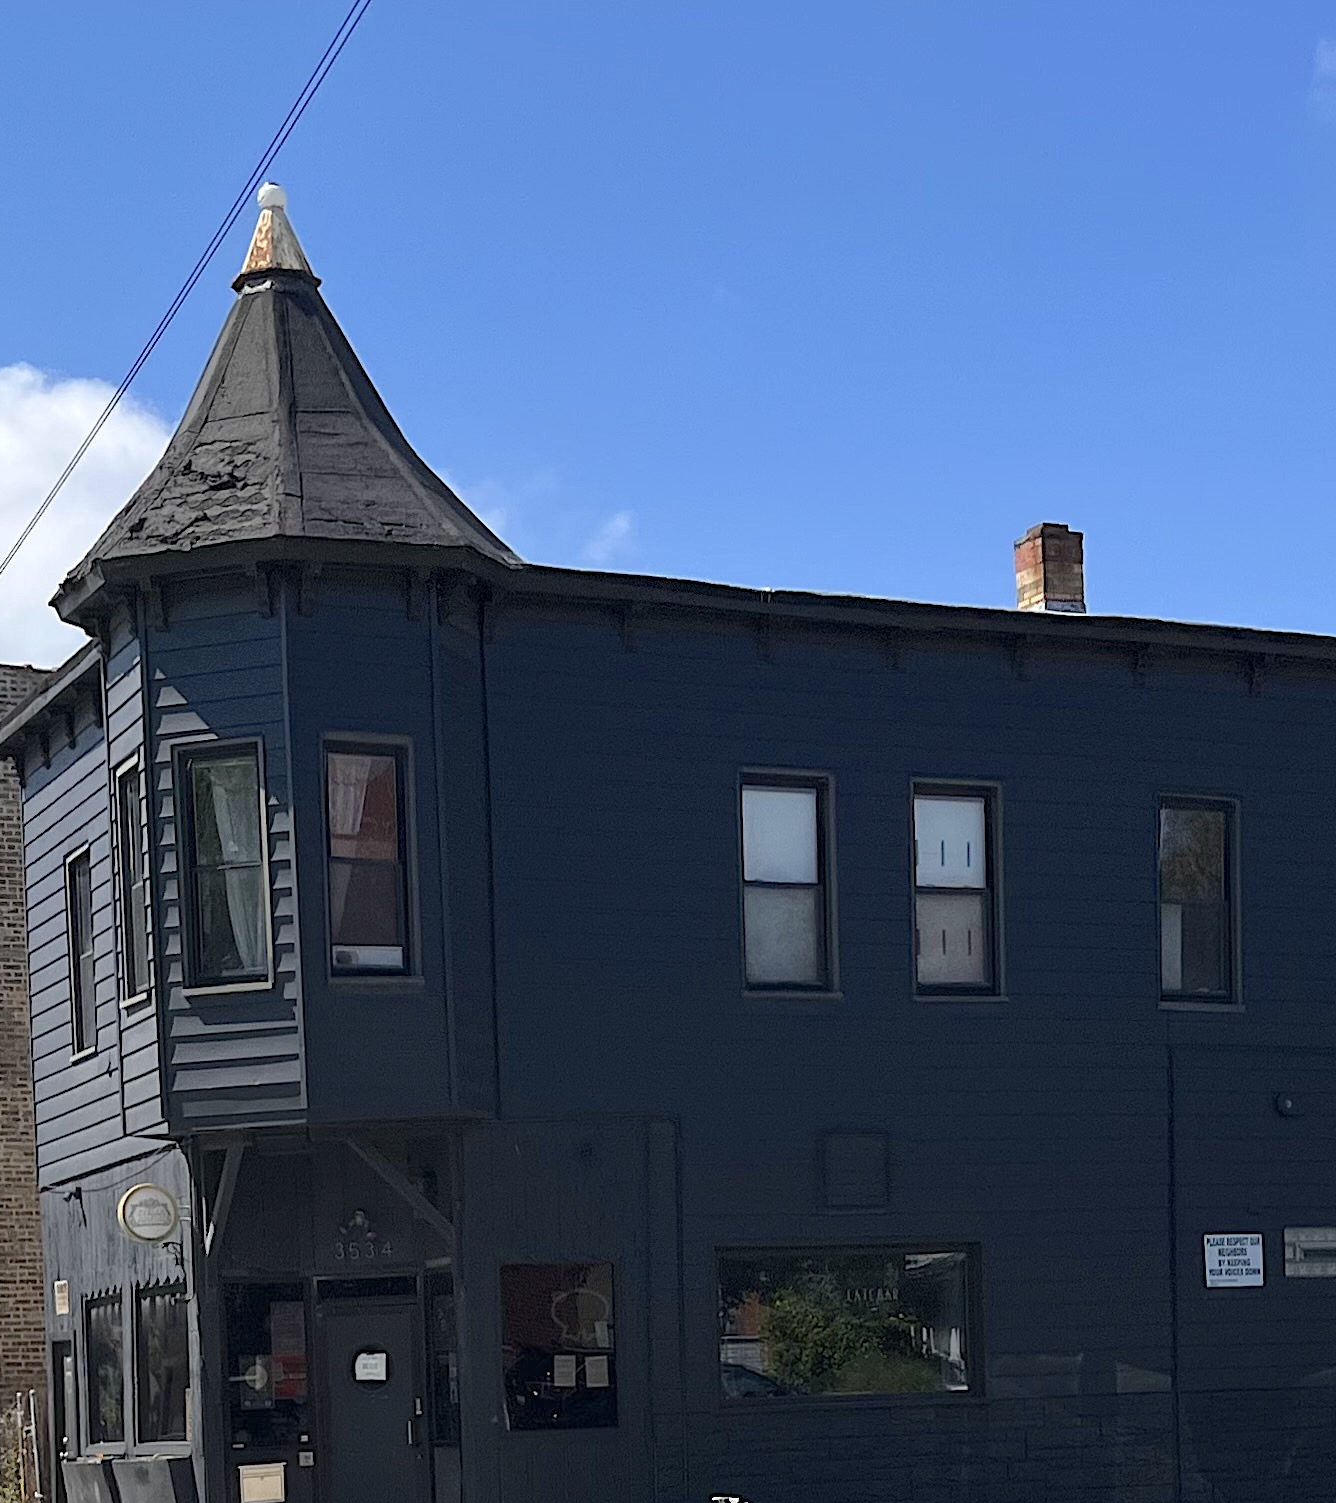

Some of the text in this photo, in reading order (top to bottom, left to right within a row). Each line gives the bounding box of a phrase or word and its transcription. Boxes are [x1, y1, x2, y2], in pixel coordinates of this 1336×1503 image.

[1207, 1236, 1260, 1247] PLEASE RESPECT OUR
[335, 1241, 393, 1260] 3534
